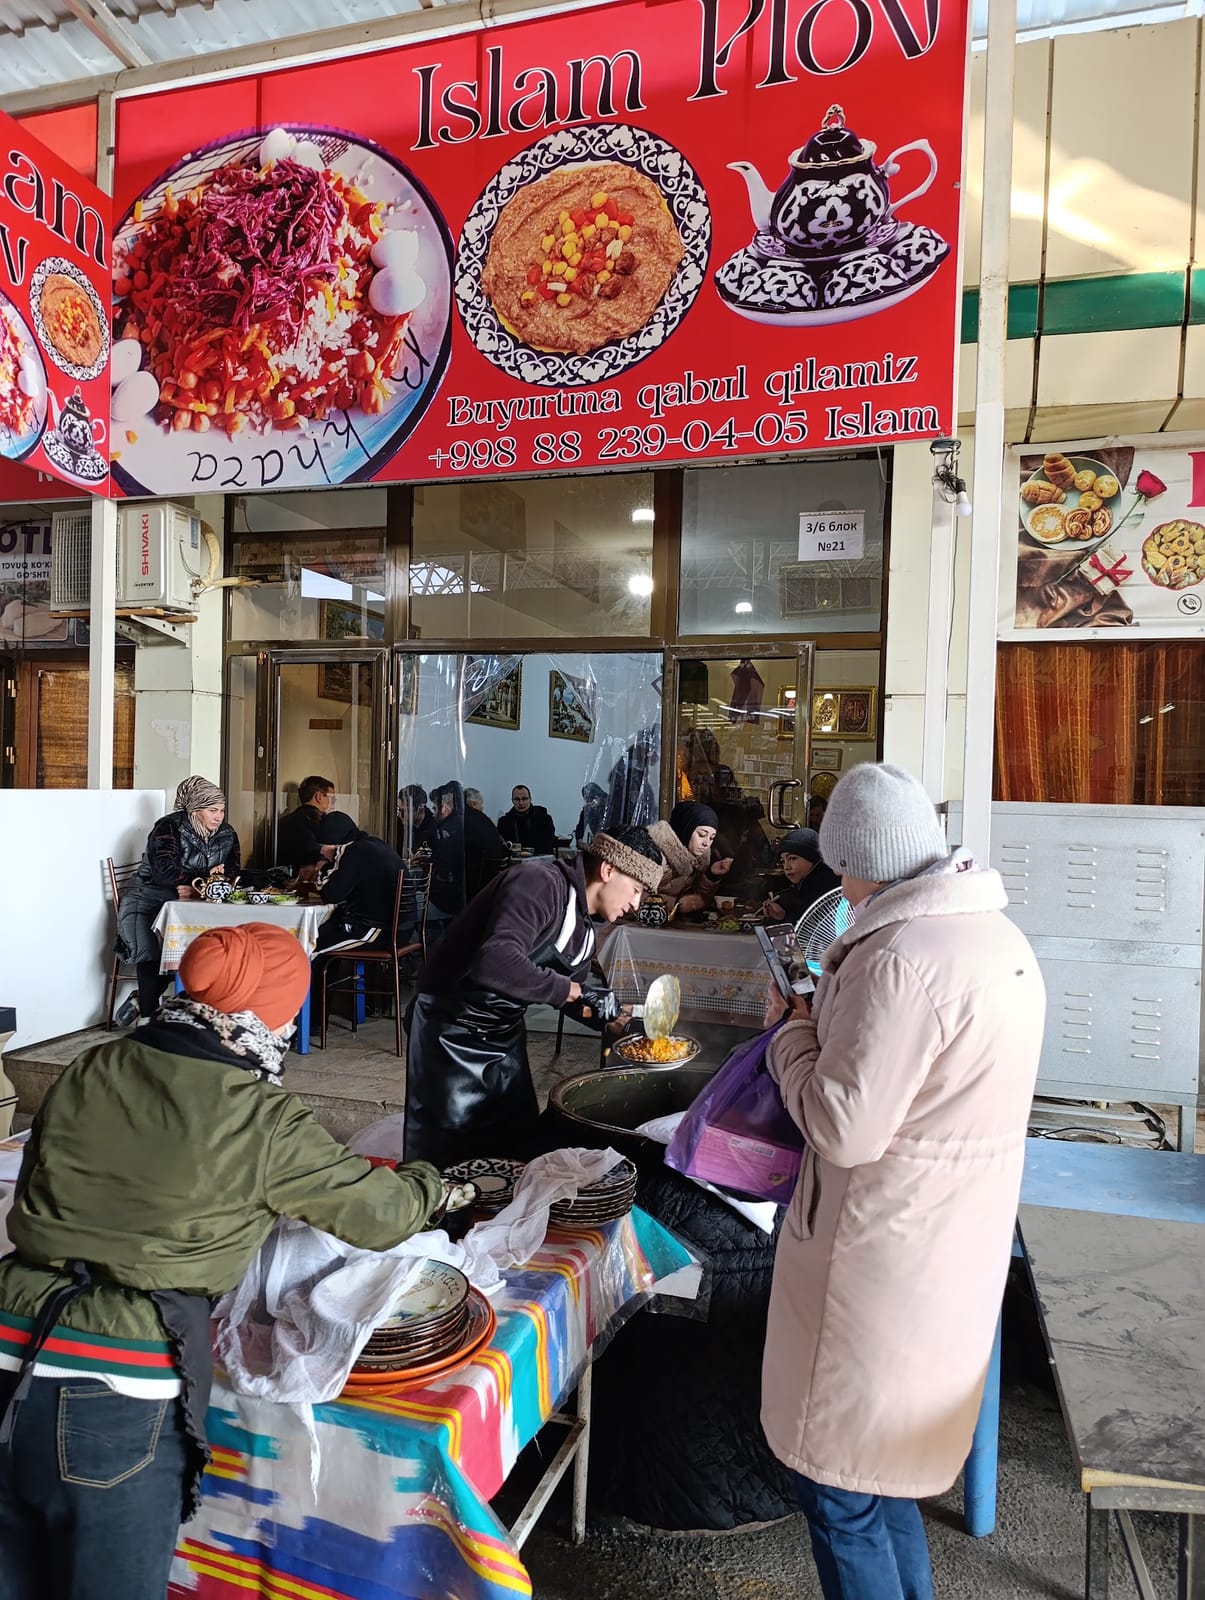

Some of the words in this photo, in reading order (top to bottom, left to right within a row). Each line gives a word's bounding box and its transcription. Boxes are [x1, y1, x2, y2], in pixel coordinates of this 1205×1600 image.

[409, 46, 646, 151] Islam
[0, 150, 109, 270] am
[187, 327, 431, 487] Bkhara
[446, 386, 622, 430] Buyurtma
[637, 364, 747, 417] qabul
[764, 352, 918, 404] qilamiz
[428, 436, 517, 470] +998
[532, 430, 581, 463] 88
[598, 409, 808, 460] 239-04-05
[824, 401, 939, 441] Islam
[141, 513, 149, 576] SHIVAKI
[805, 521, 826, 534] 3/6
[828, 521, 857, 532] блок
[817, 541, 846, 552] №21
